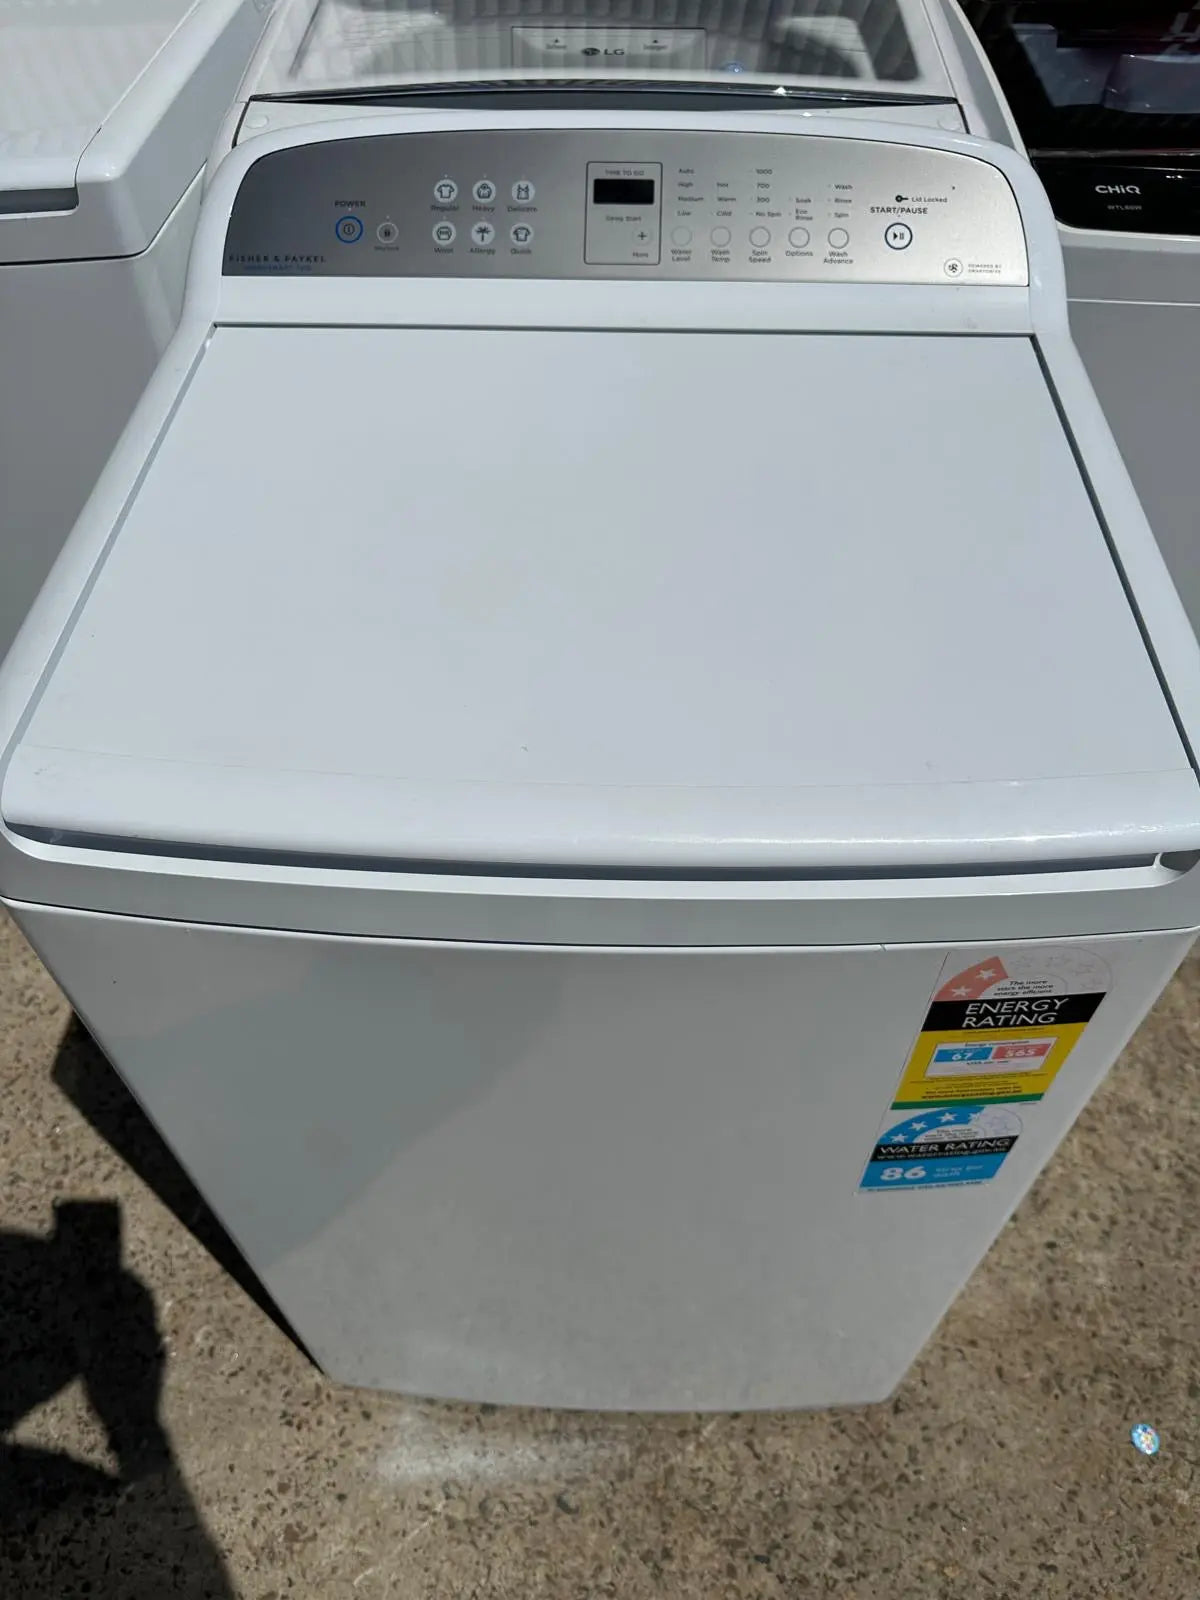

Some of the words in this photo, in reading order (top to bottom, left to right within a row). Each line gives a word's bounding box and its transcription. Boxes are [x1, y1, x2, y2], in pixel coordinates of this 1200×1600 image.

[603, 48, 625, 56] LG
[1095, 185, 1141, 194] CHiQ
[430, 204, 459, 212] Regular
[472, 205, 495, 213] Heavy
[869, 206, 928, 214] START/PAUSE
[964, 998, 1070, 1016] ENERGY
[961, 1012, 1057, 1029] RATING
[951, 1052, 972, 1061] 67
[880, 1143, 940, 1154] WATER
[944, 1138, 1011, 1150] RATING
[880, 1166, 927, 1181] 86
